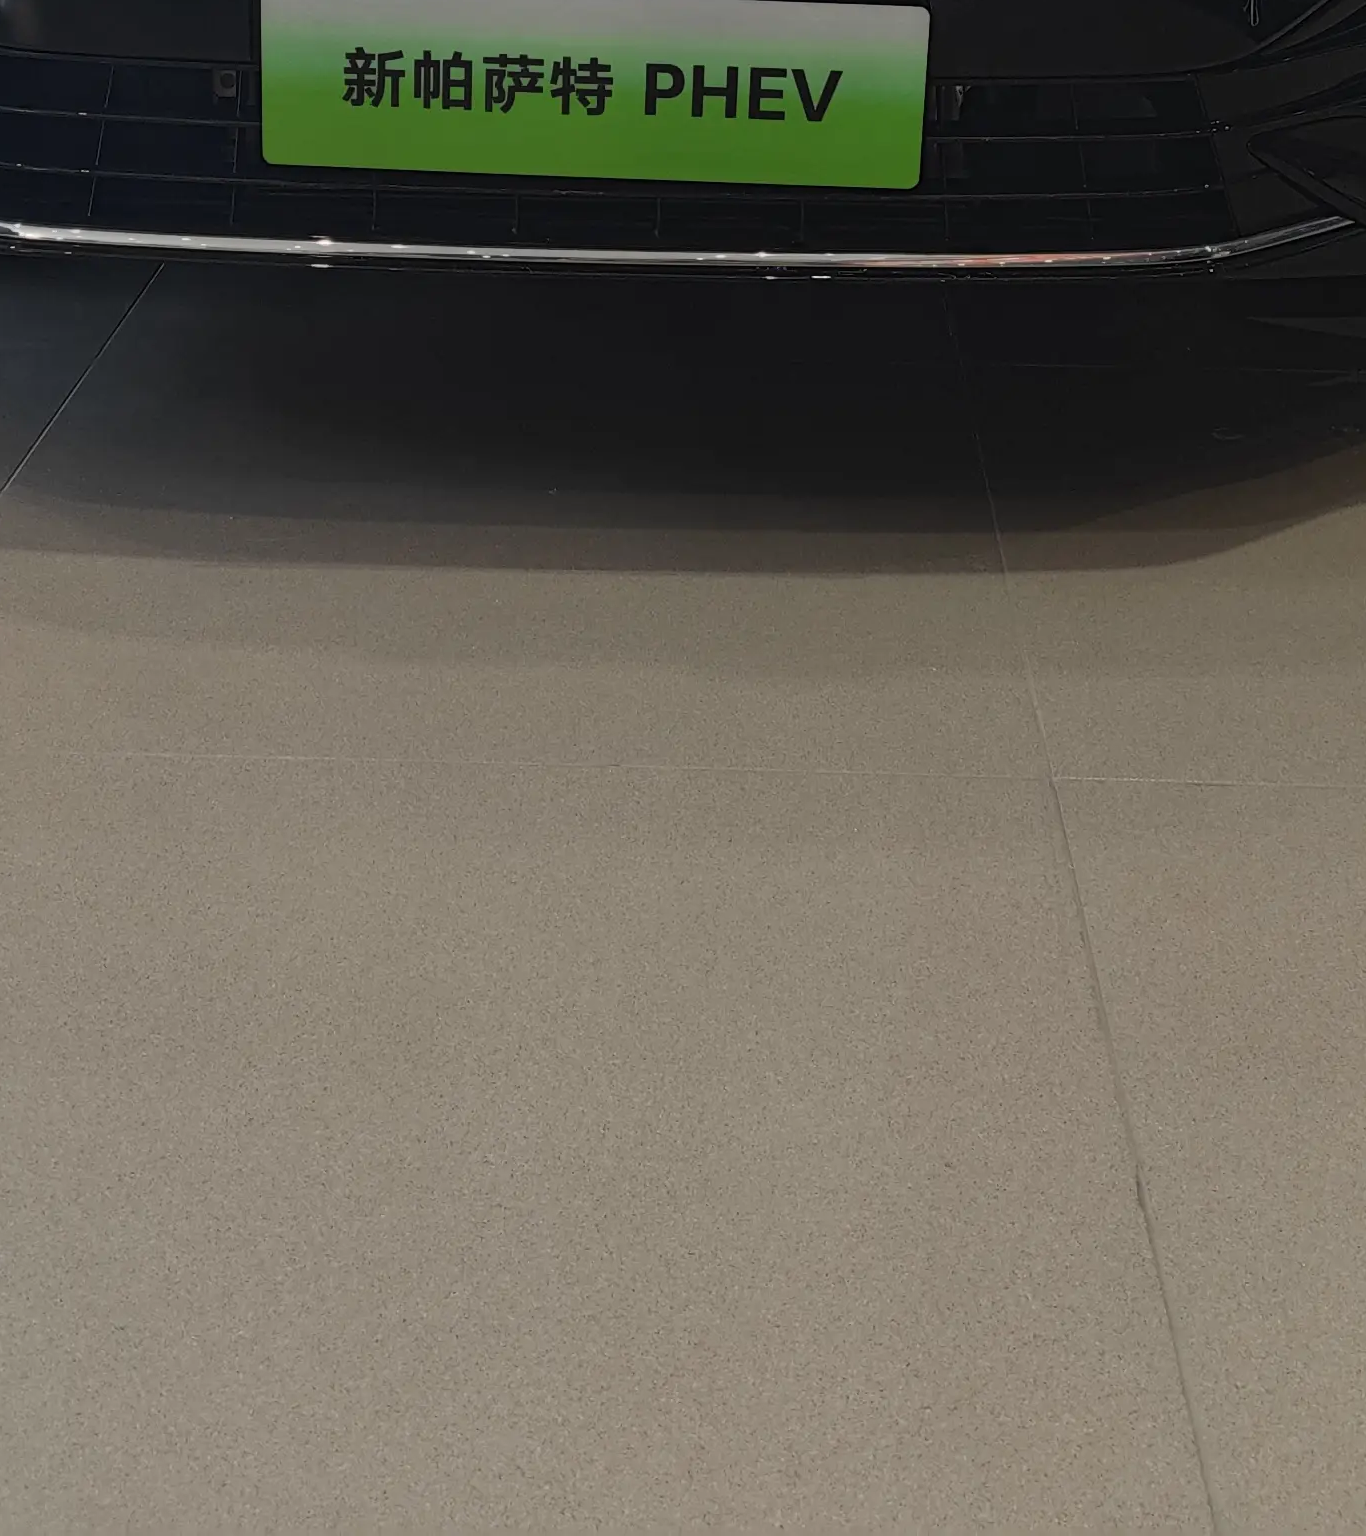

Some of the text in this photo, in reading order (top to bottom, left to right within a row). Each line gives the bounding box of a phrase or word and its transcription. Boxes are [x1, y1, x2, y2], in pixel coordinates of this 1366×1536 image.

[342, 46, 843, 122] 新帕萨特 PHEV
